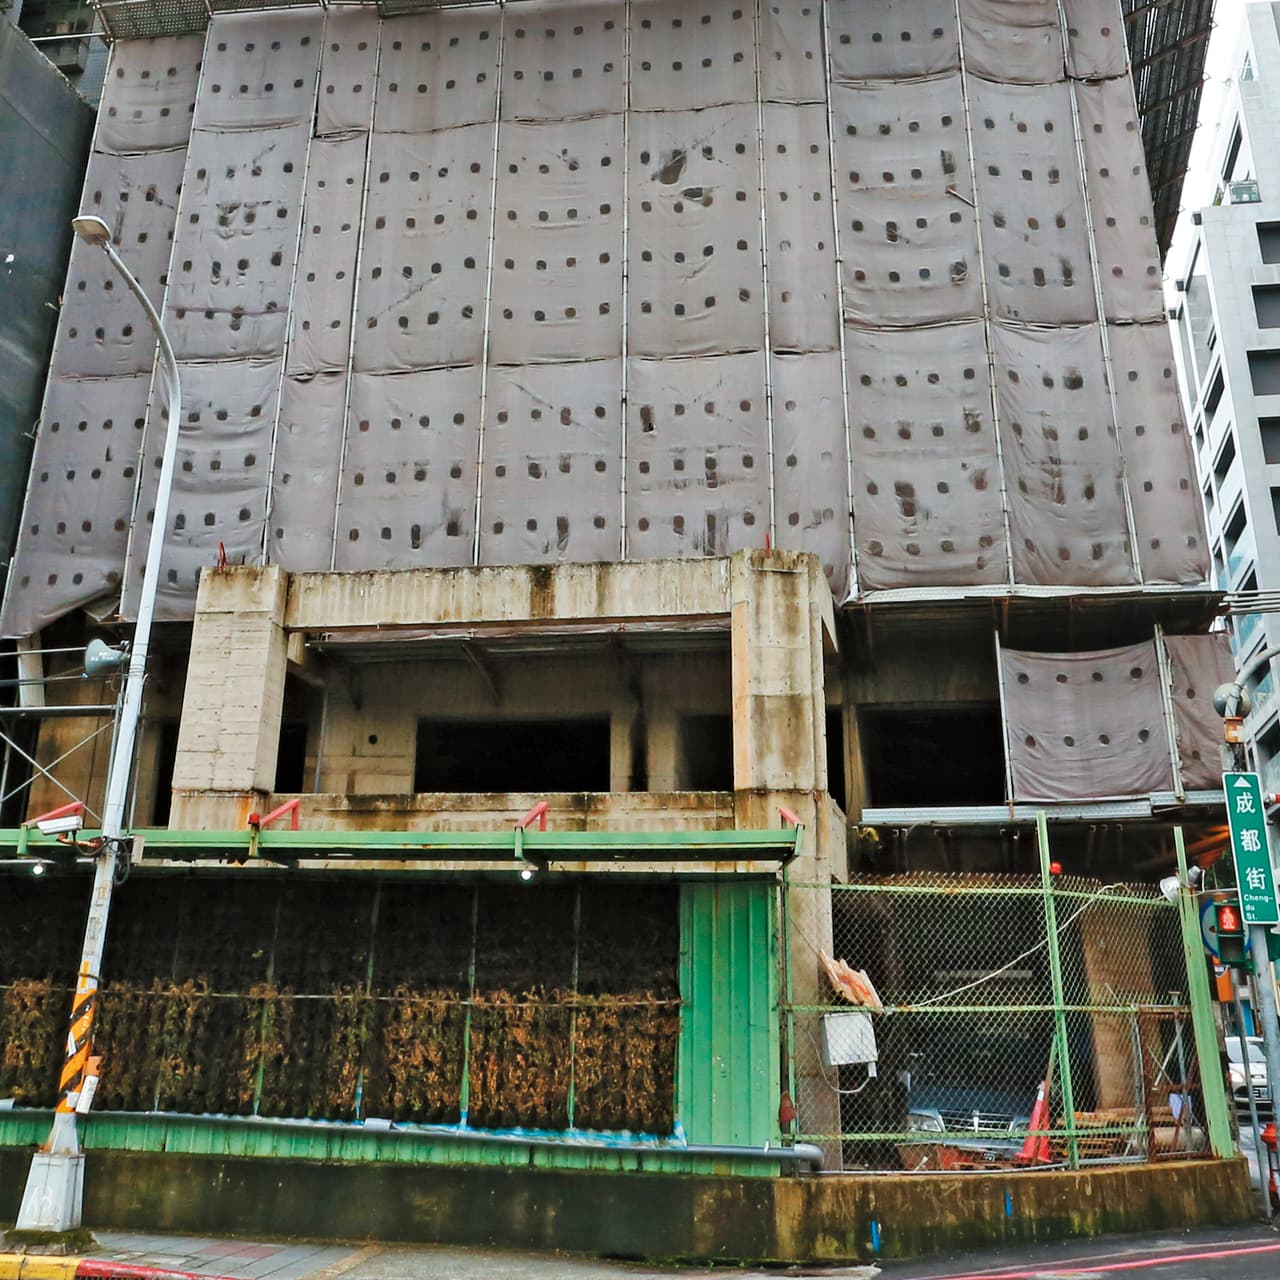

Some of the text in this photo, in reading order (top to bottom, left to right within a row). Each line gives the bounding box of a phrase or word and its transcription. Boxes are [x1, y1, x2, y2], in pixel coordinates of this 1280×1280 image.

[1235, 791, 1266, 891] 成都街
[1243, 893, 1273, 903] Cheng-
